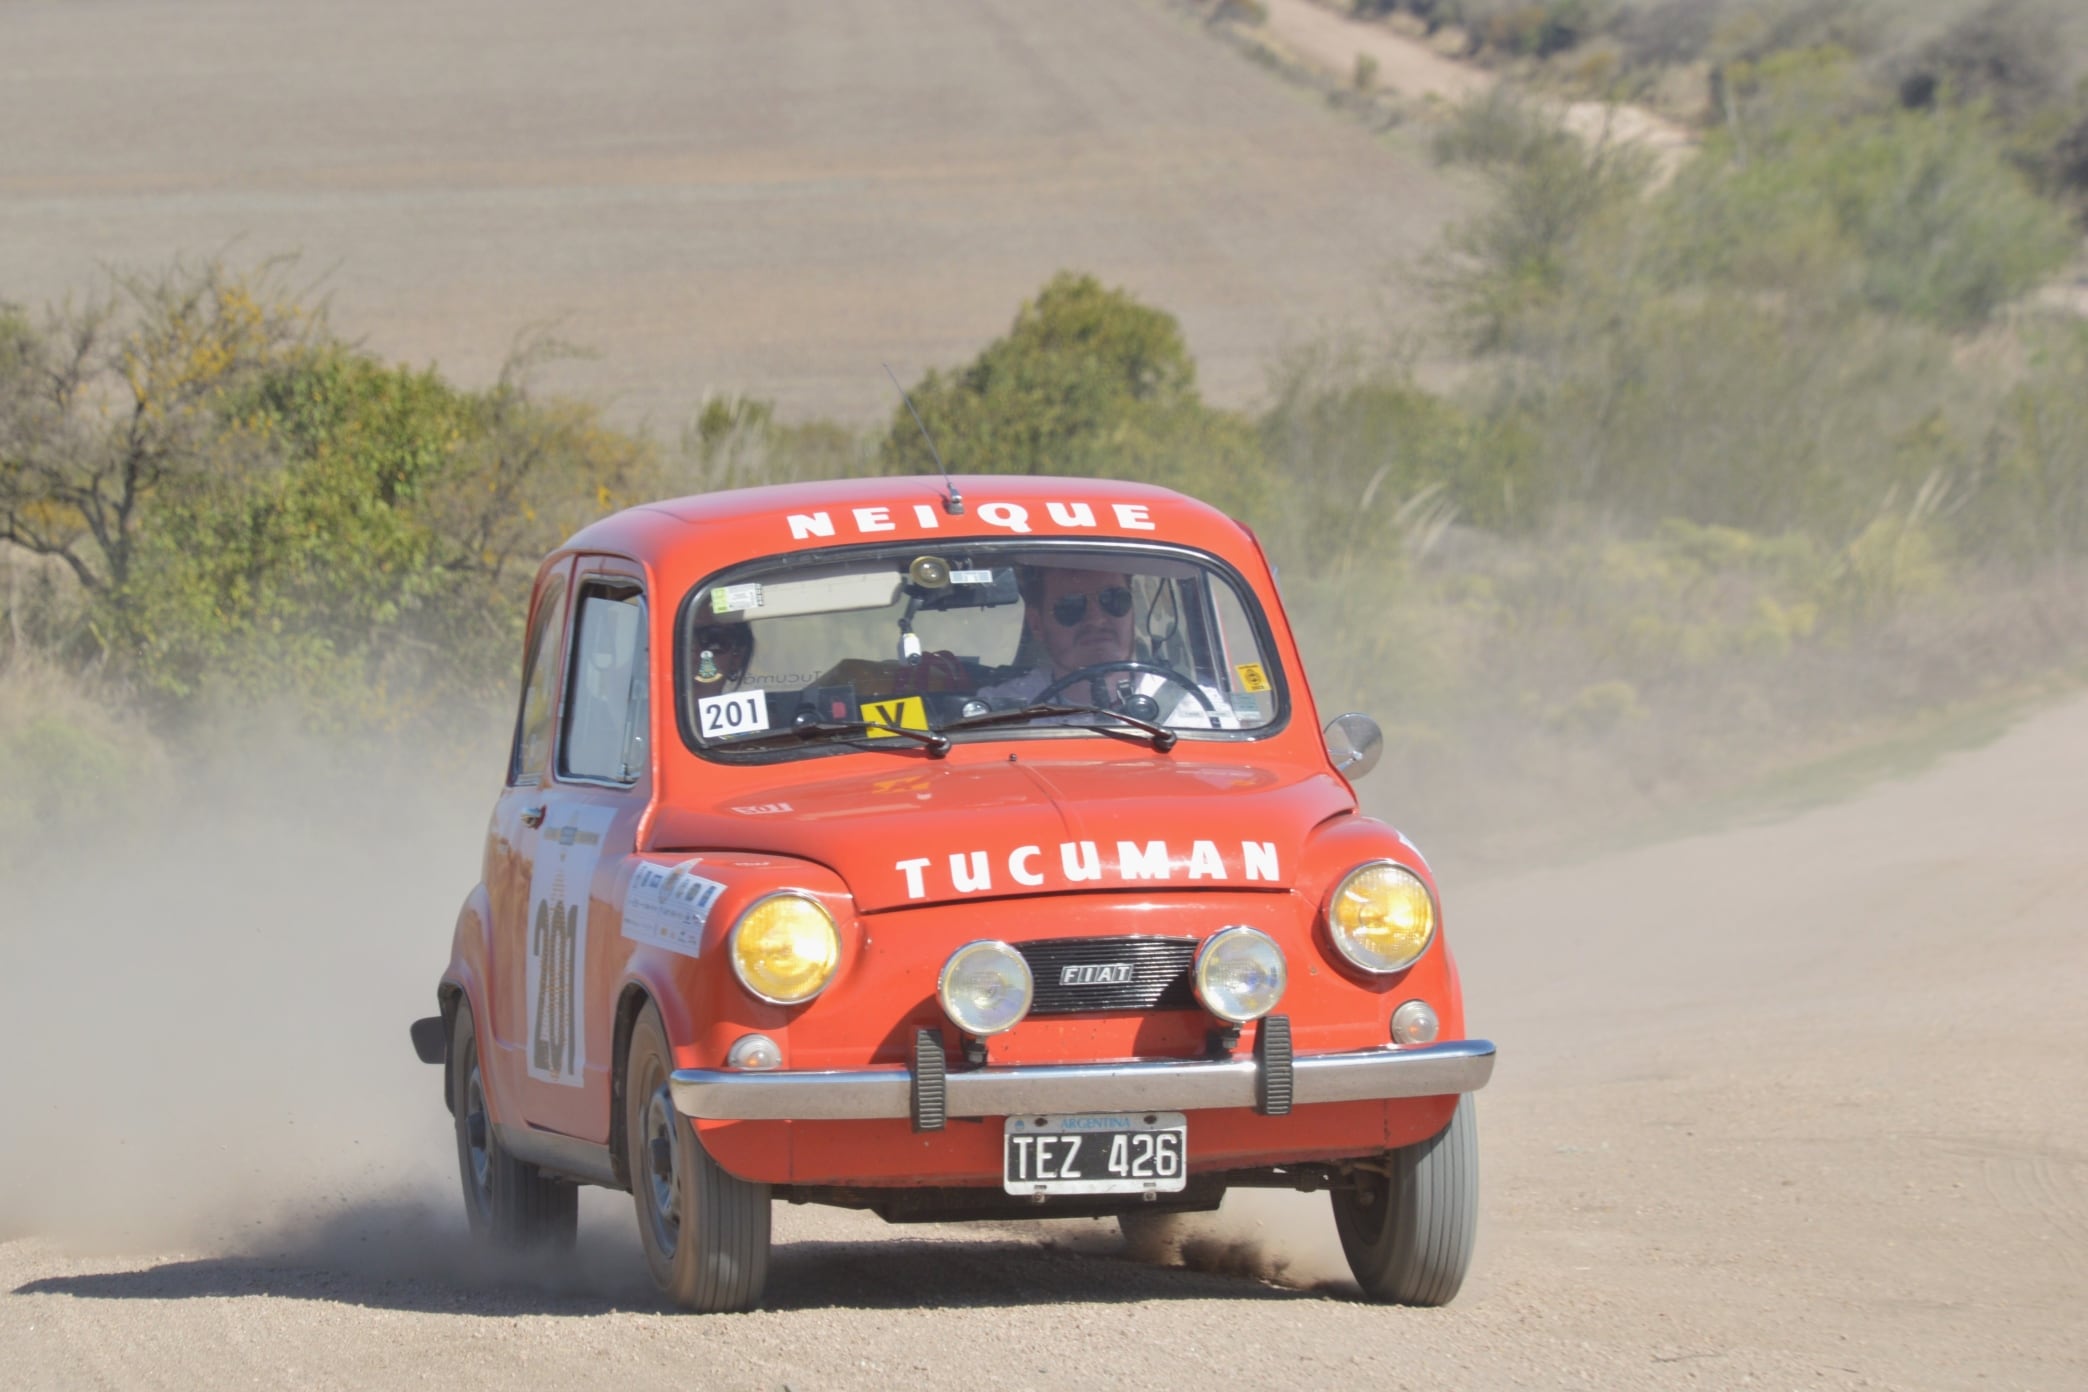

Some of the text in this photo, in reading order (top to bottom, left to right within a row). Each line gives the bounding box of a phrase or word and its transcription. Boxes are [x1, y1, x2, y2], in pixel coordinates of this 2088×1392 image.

[786, 502, 1156, 540] NEIQUE
[706, 699, 757, 730] 201
[875, 702, 904, 728] V
[895, 840, 1280, 899] TUCUMAN
[1063, 966, 1130, 983] FIAT
[1060, 1117, 1130, 1129] ARGENTINA
[1012, 1133, 1178, 1179] TEZ 426
